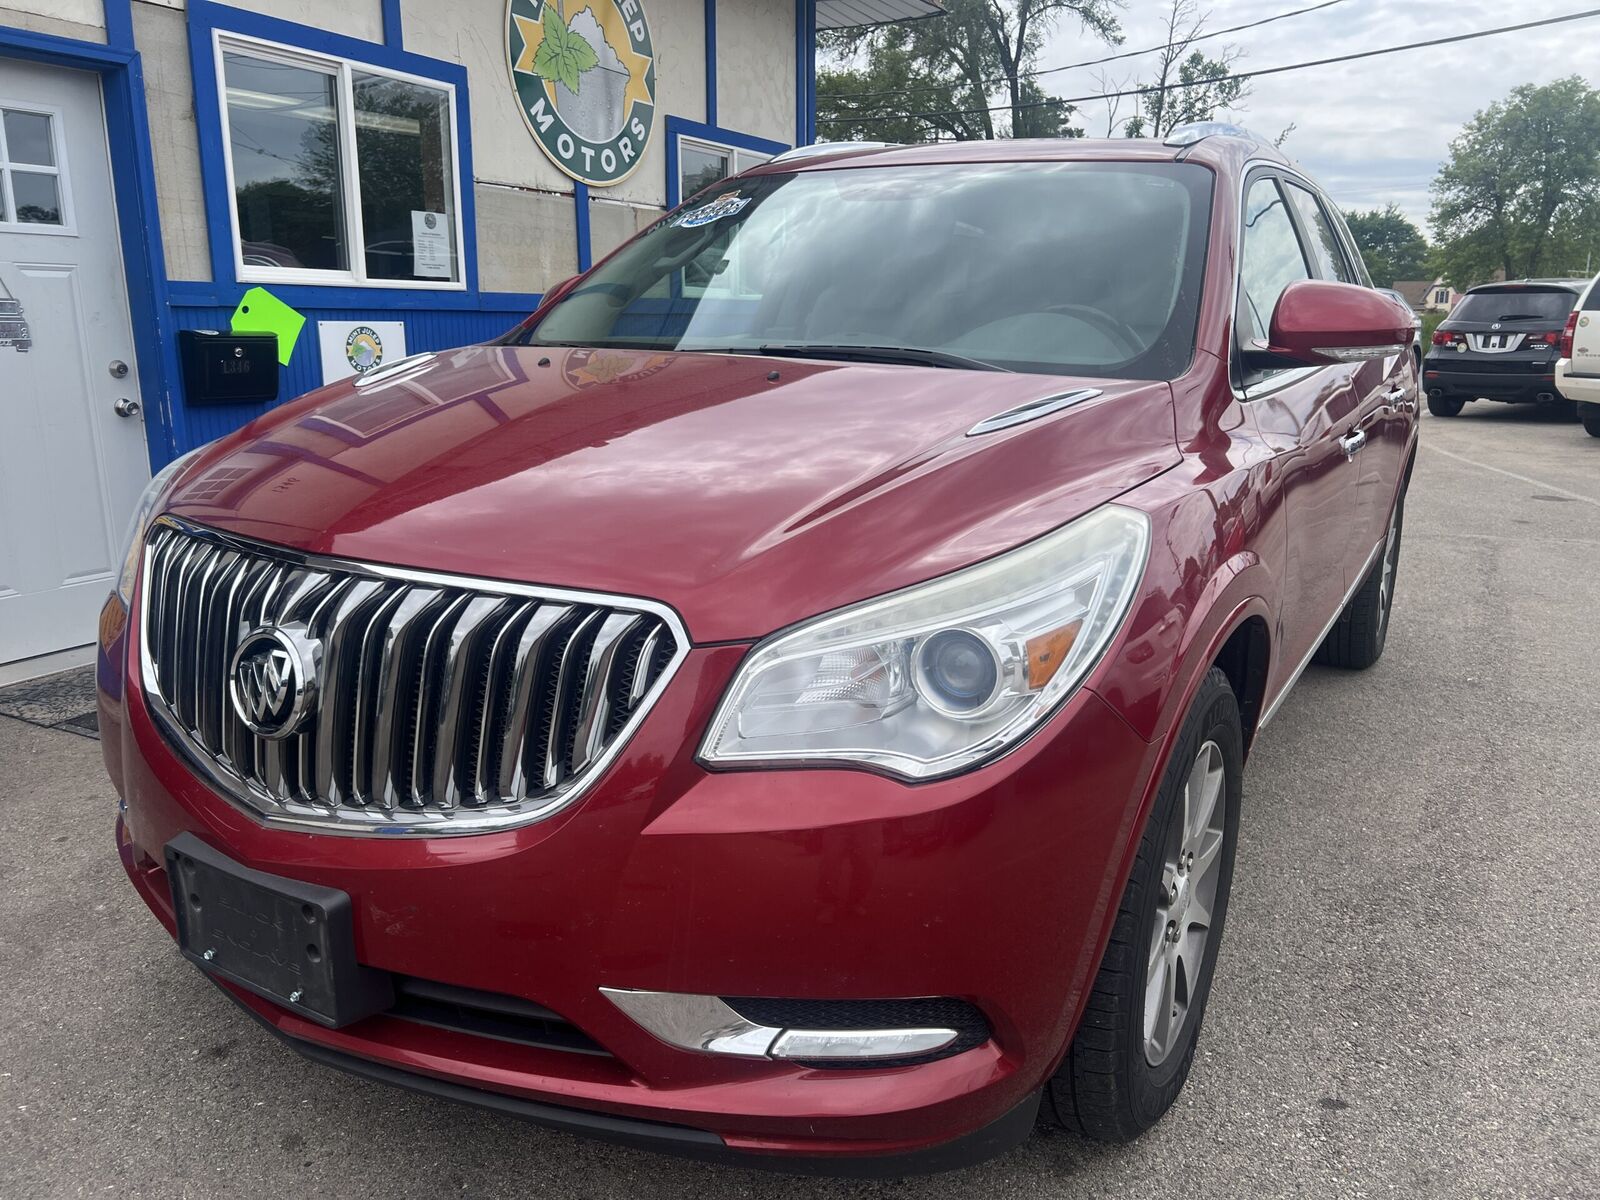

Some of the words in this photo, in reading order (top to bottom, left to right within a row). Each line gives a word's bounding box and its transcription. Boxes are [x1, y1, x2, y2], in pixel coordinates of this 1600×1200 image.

[530, 97, 645, 173] MOTORS
[348, 328, 361, 343] MINT
[362, 327, 380, 344] JULEP
